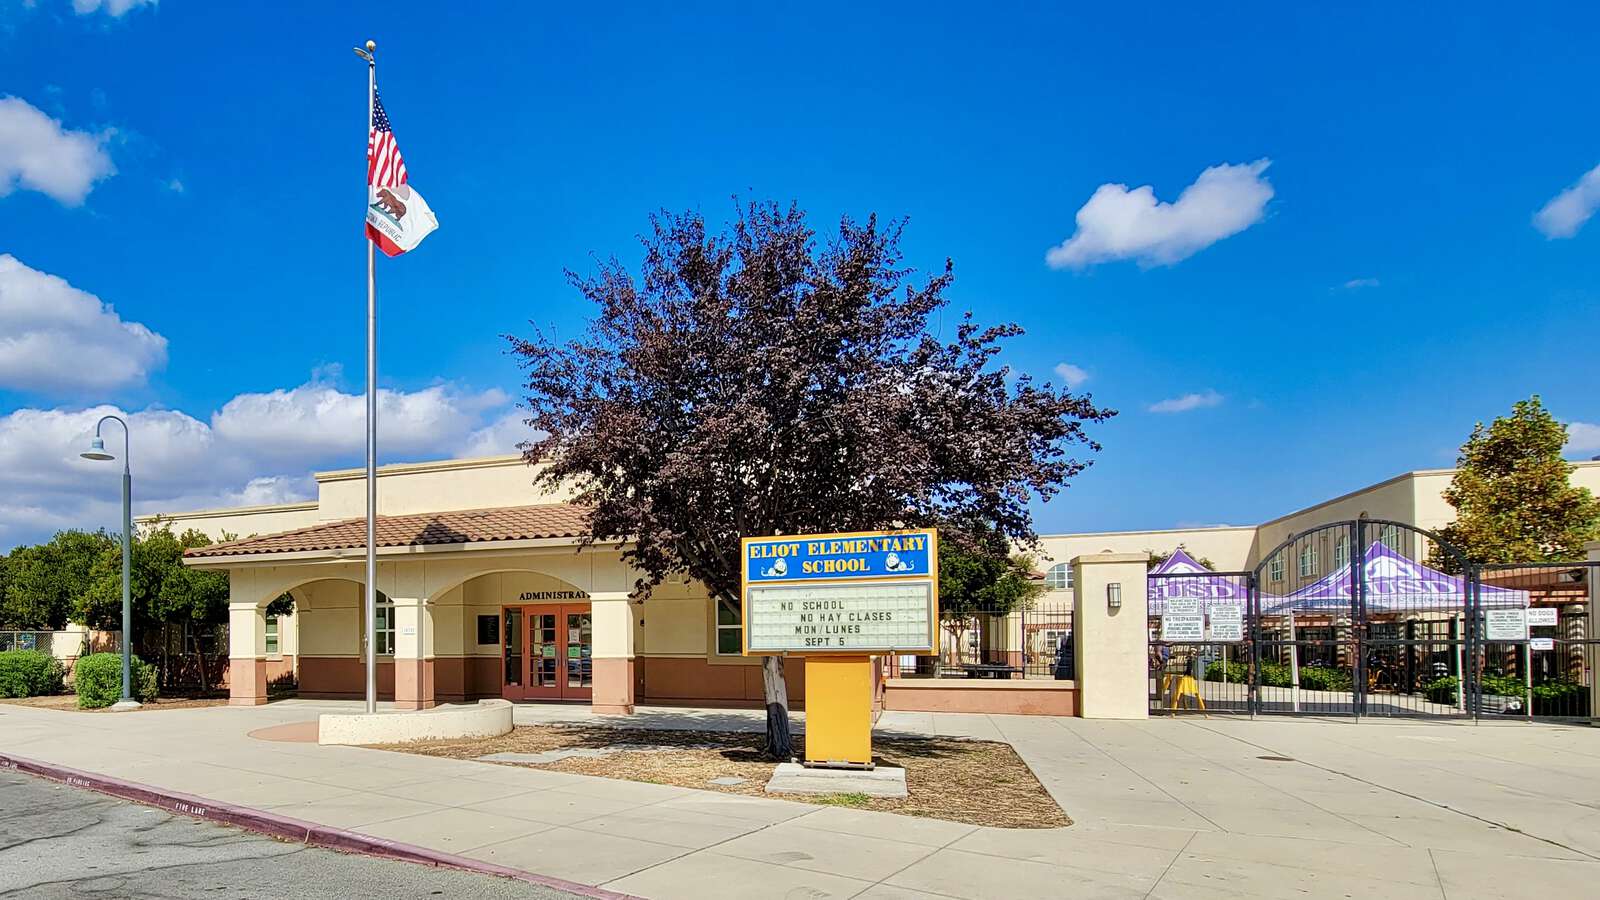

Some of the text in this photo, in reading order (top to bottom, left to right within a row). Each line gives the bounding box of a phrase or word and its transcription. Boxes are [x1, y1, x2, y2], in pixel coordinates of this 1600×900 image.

[750, 536, 926, 559] ELIOT ELEMENTARY
[802, 558, 870, 573] SCHOOL
[519, 590, 587, 600] ADMINISTRAT
[781, 601, 845, 611] NO SCHOOL
[800, 612, 892, 622] NO HAY CLASES
[795, 625, 861, 635] MON/LUNES
[805, 636, 845, 646] SEPT 5
